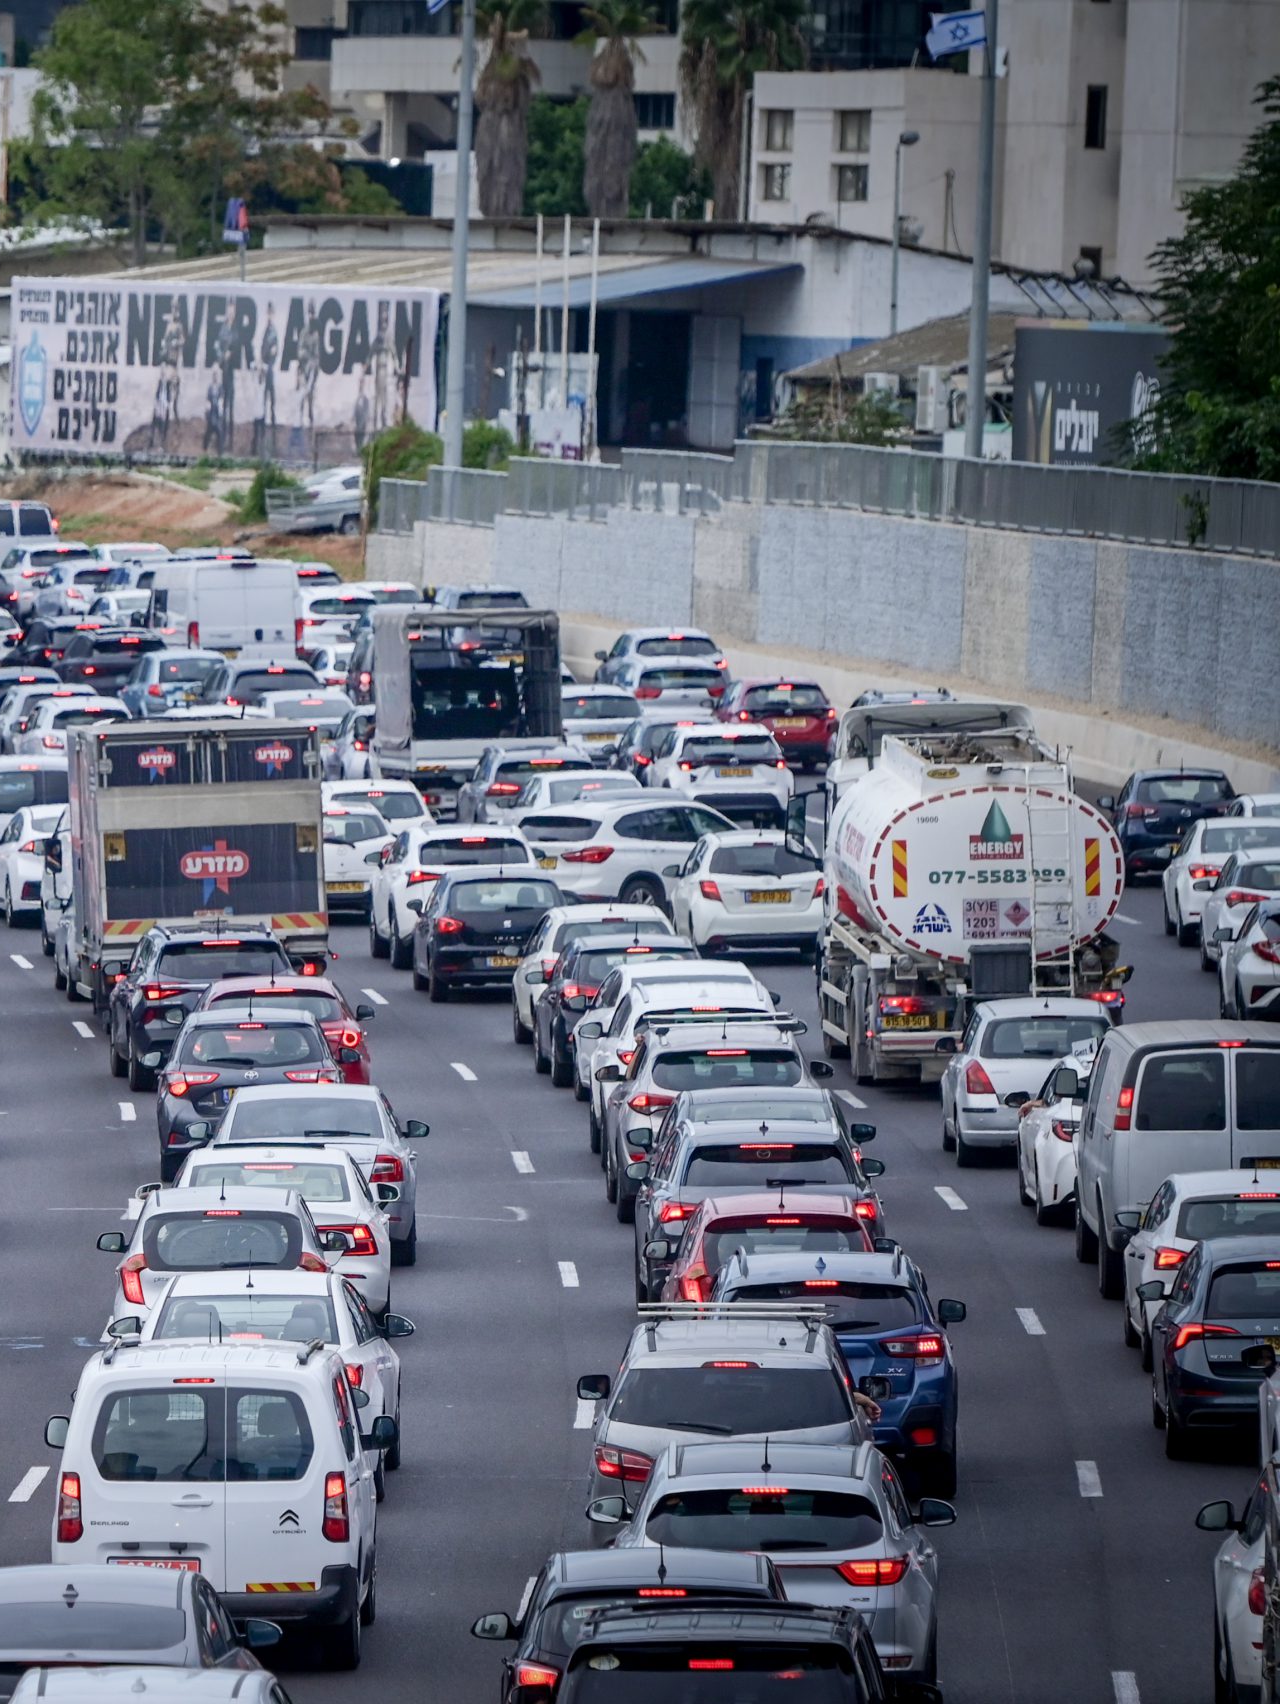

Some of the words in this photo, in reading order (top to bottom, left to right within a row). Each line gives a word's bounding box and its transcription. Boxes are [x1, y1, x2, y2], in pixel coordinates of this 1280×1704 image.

[55, 290, 121, 326] אוהבים
[126, 293, 258, 370] NEVER
[60, 330, 120, 364] אתכם.
[53, 369, 118, 403] סומכים
[51, 407, 117, 443] עליכם.
[1055, 398, 1100, 453] יובלים
[140, 753, 173, 766] מזרע
[257, 748, 290, 761] מזרע
[916, 816, 939, 824] 19000
[970, 841, 1023, 855] ENERGY
[184, 854, 245, 874] מזרע
[965, 917, 996, 929] 1203
